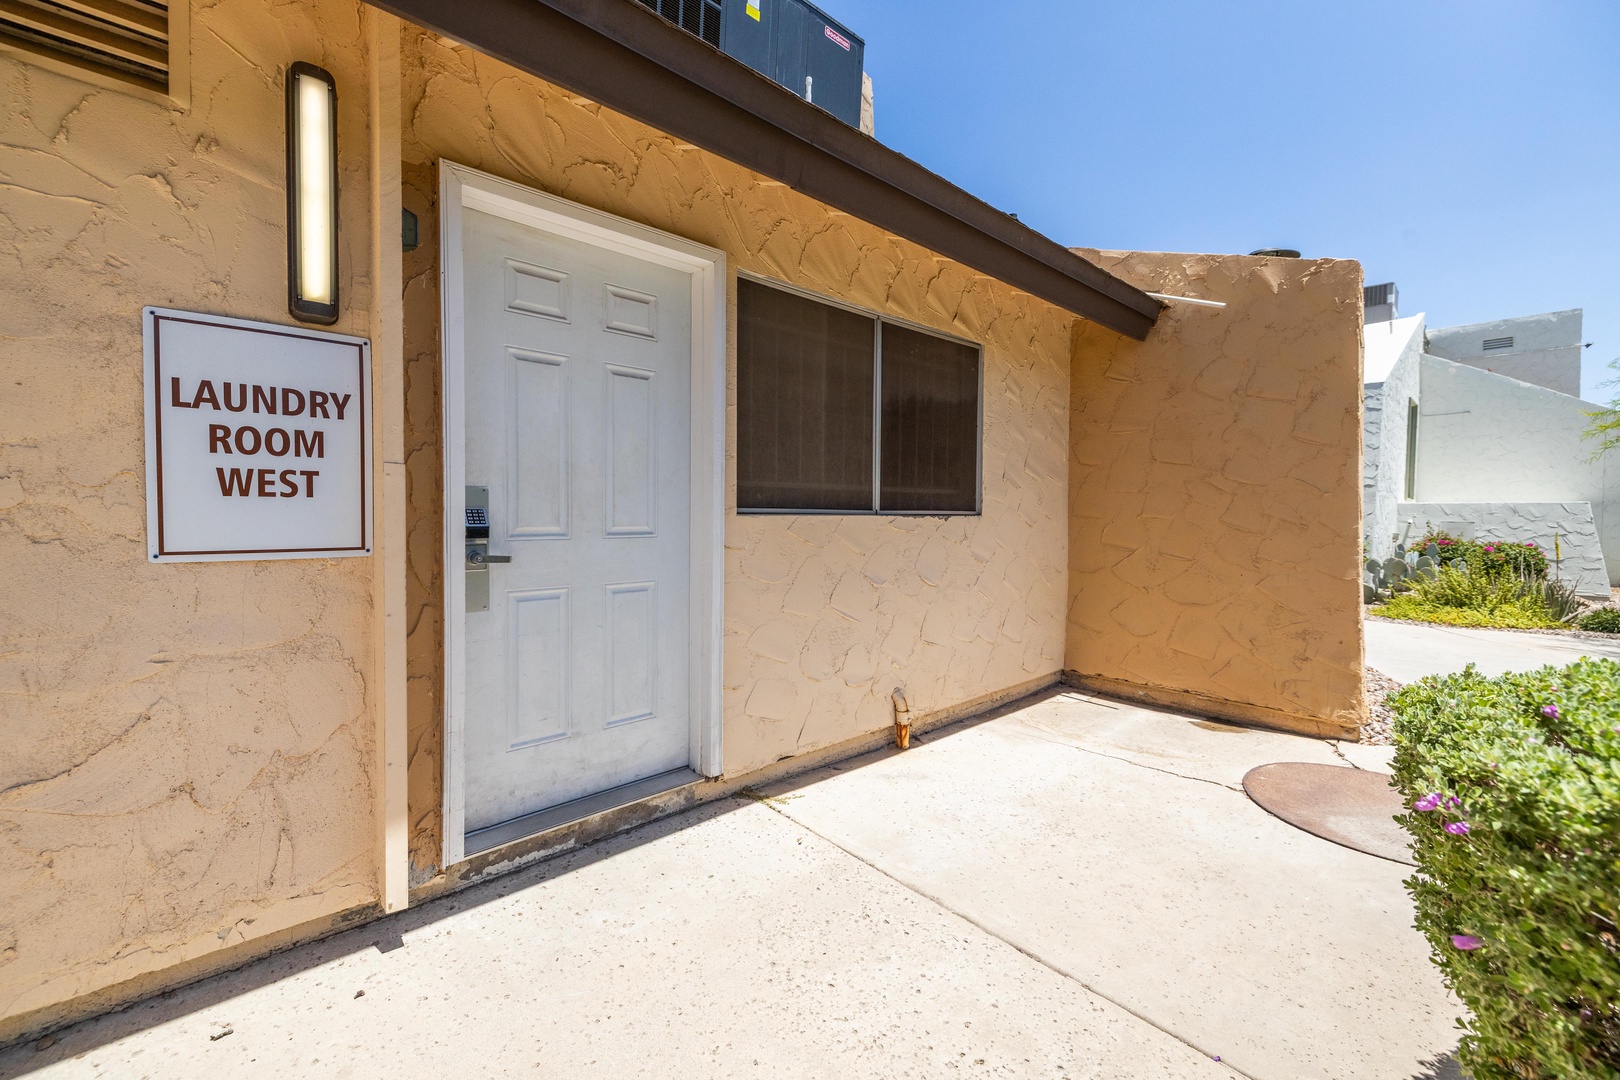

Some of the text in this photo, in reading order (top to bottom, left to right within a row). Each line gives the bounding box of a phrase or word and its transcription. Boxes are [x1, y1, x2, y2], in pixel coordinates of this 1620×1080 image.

[171, 376, 352, 420] LAUNDRY
[208, 423, 325, 459] ROOM
[215, 467, 320, 498] WEST
